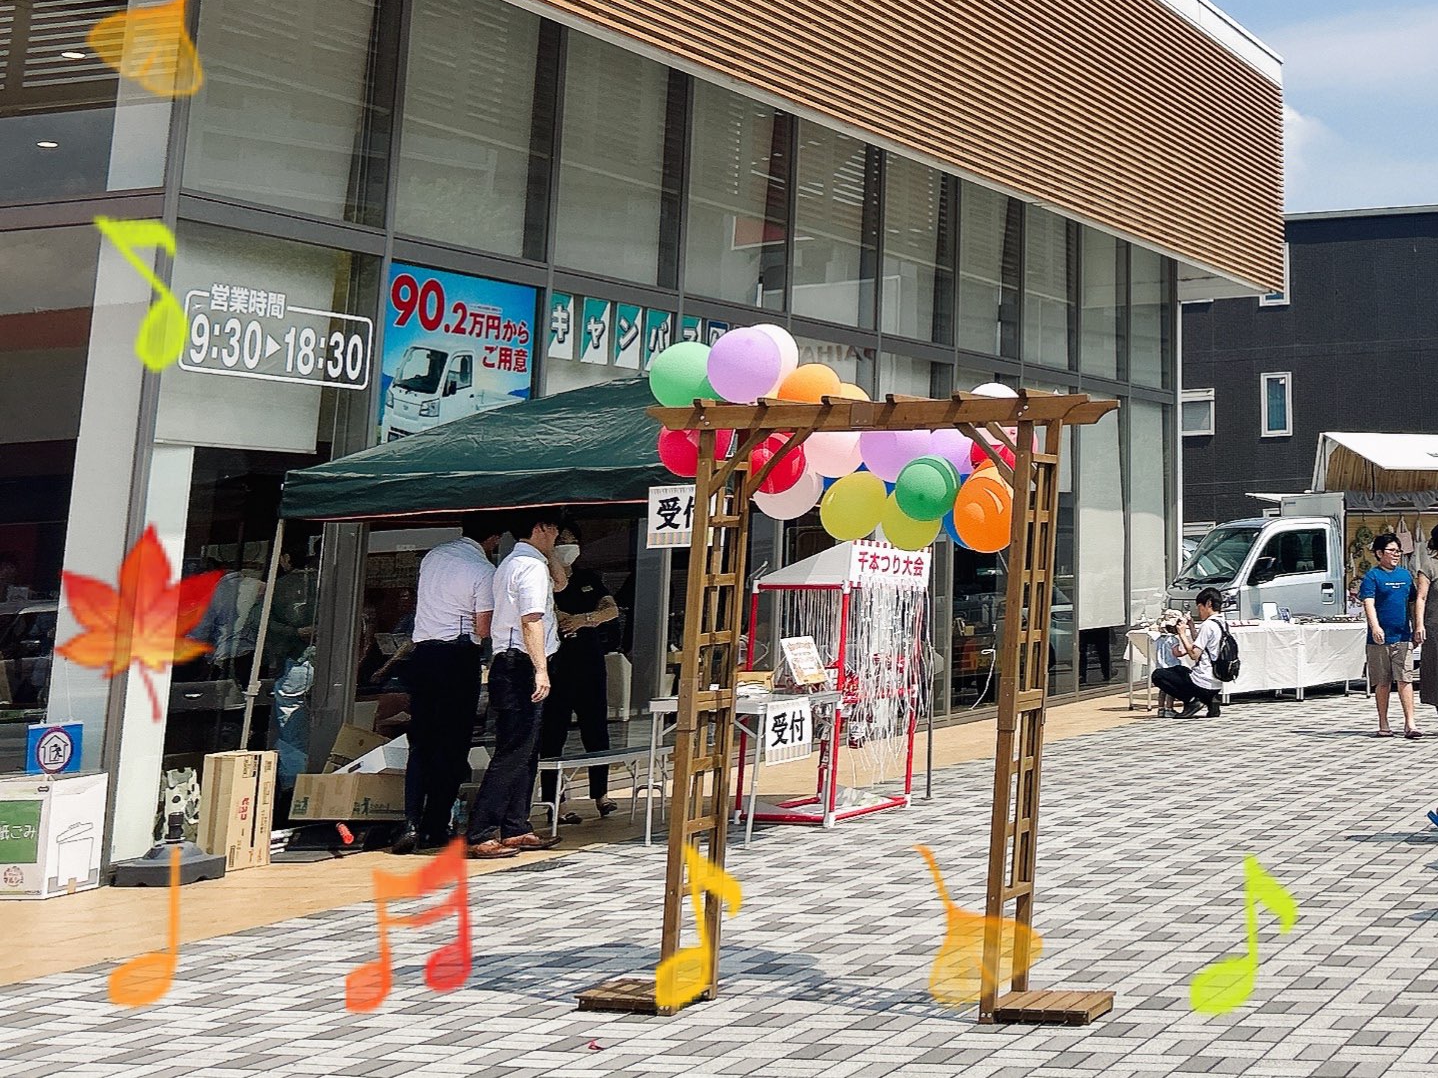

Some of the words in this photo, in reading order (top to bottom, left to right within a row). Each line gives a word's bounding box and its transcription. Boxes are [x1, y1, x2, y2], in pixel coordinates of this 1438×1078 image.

[210, 283, 286, 319] 営業時間
[391, 273, 530, 344] 90.2万円から
[190, 313, 263, 370] 9:30
[284, 326, 363, 381] 18:30
[482, 345, 528, 373] ご用意
[858, 551, 925, 577] 千本つり大会
[771, 710, 805, 747] 受付
